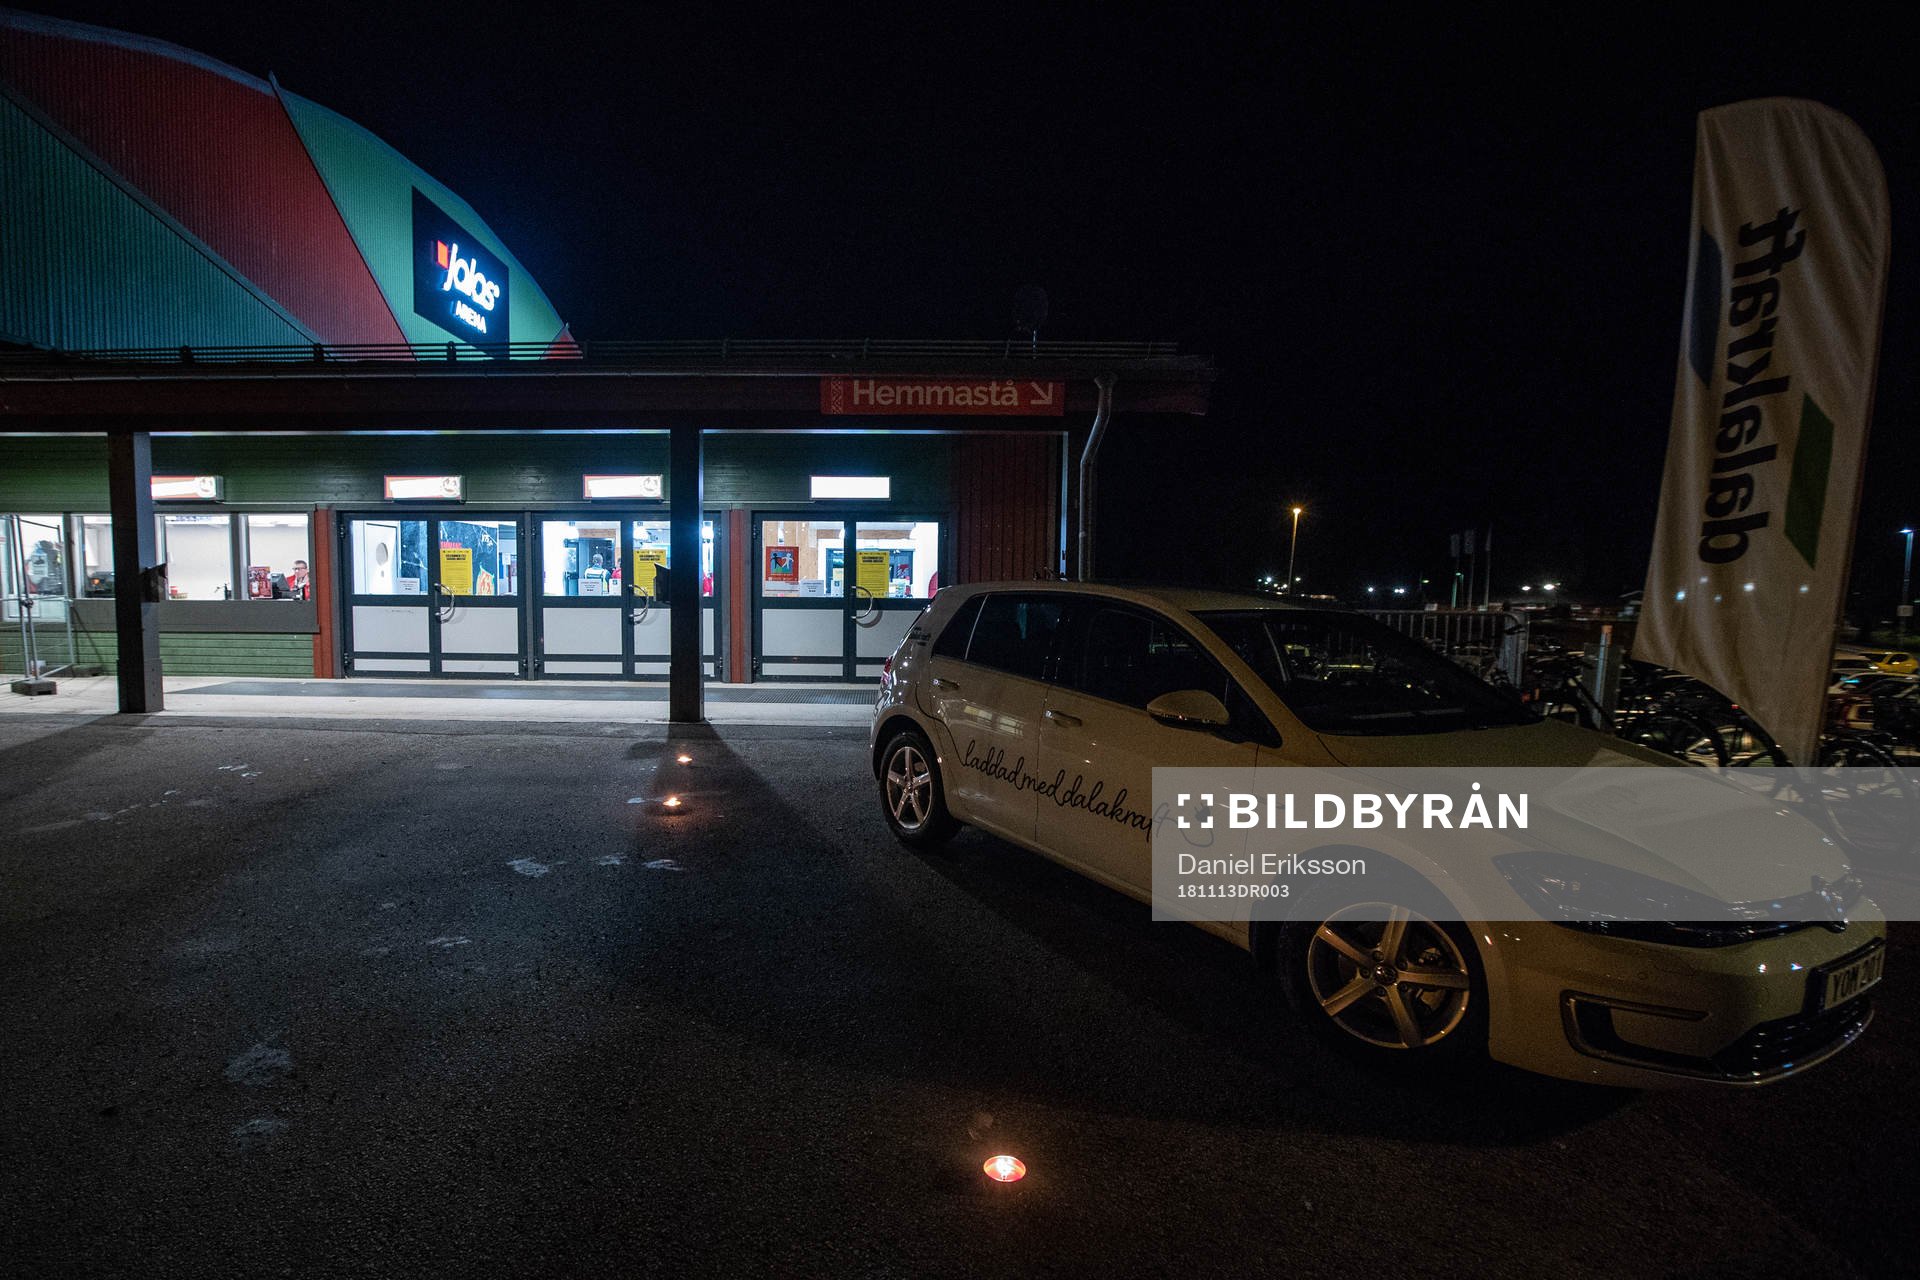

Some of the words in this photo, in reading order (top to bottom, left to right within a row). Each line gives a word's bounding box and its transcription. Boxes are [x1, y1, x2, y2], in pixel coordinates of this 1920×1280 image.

[853, 379, 1019, 406] Hemmastå
[964, 739, 1024, 790] laddad
[1022, 769, 1066, 806] med
